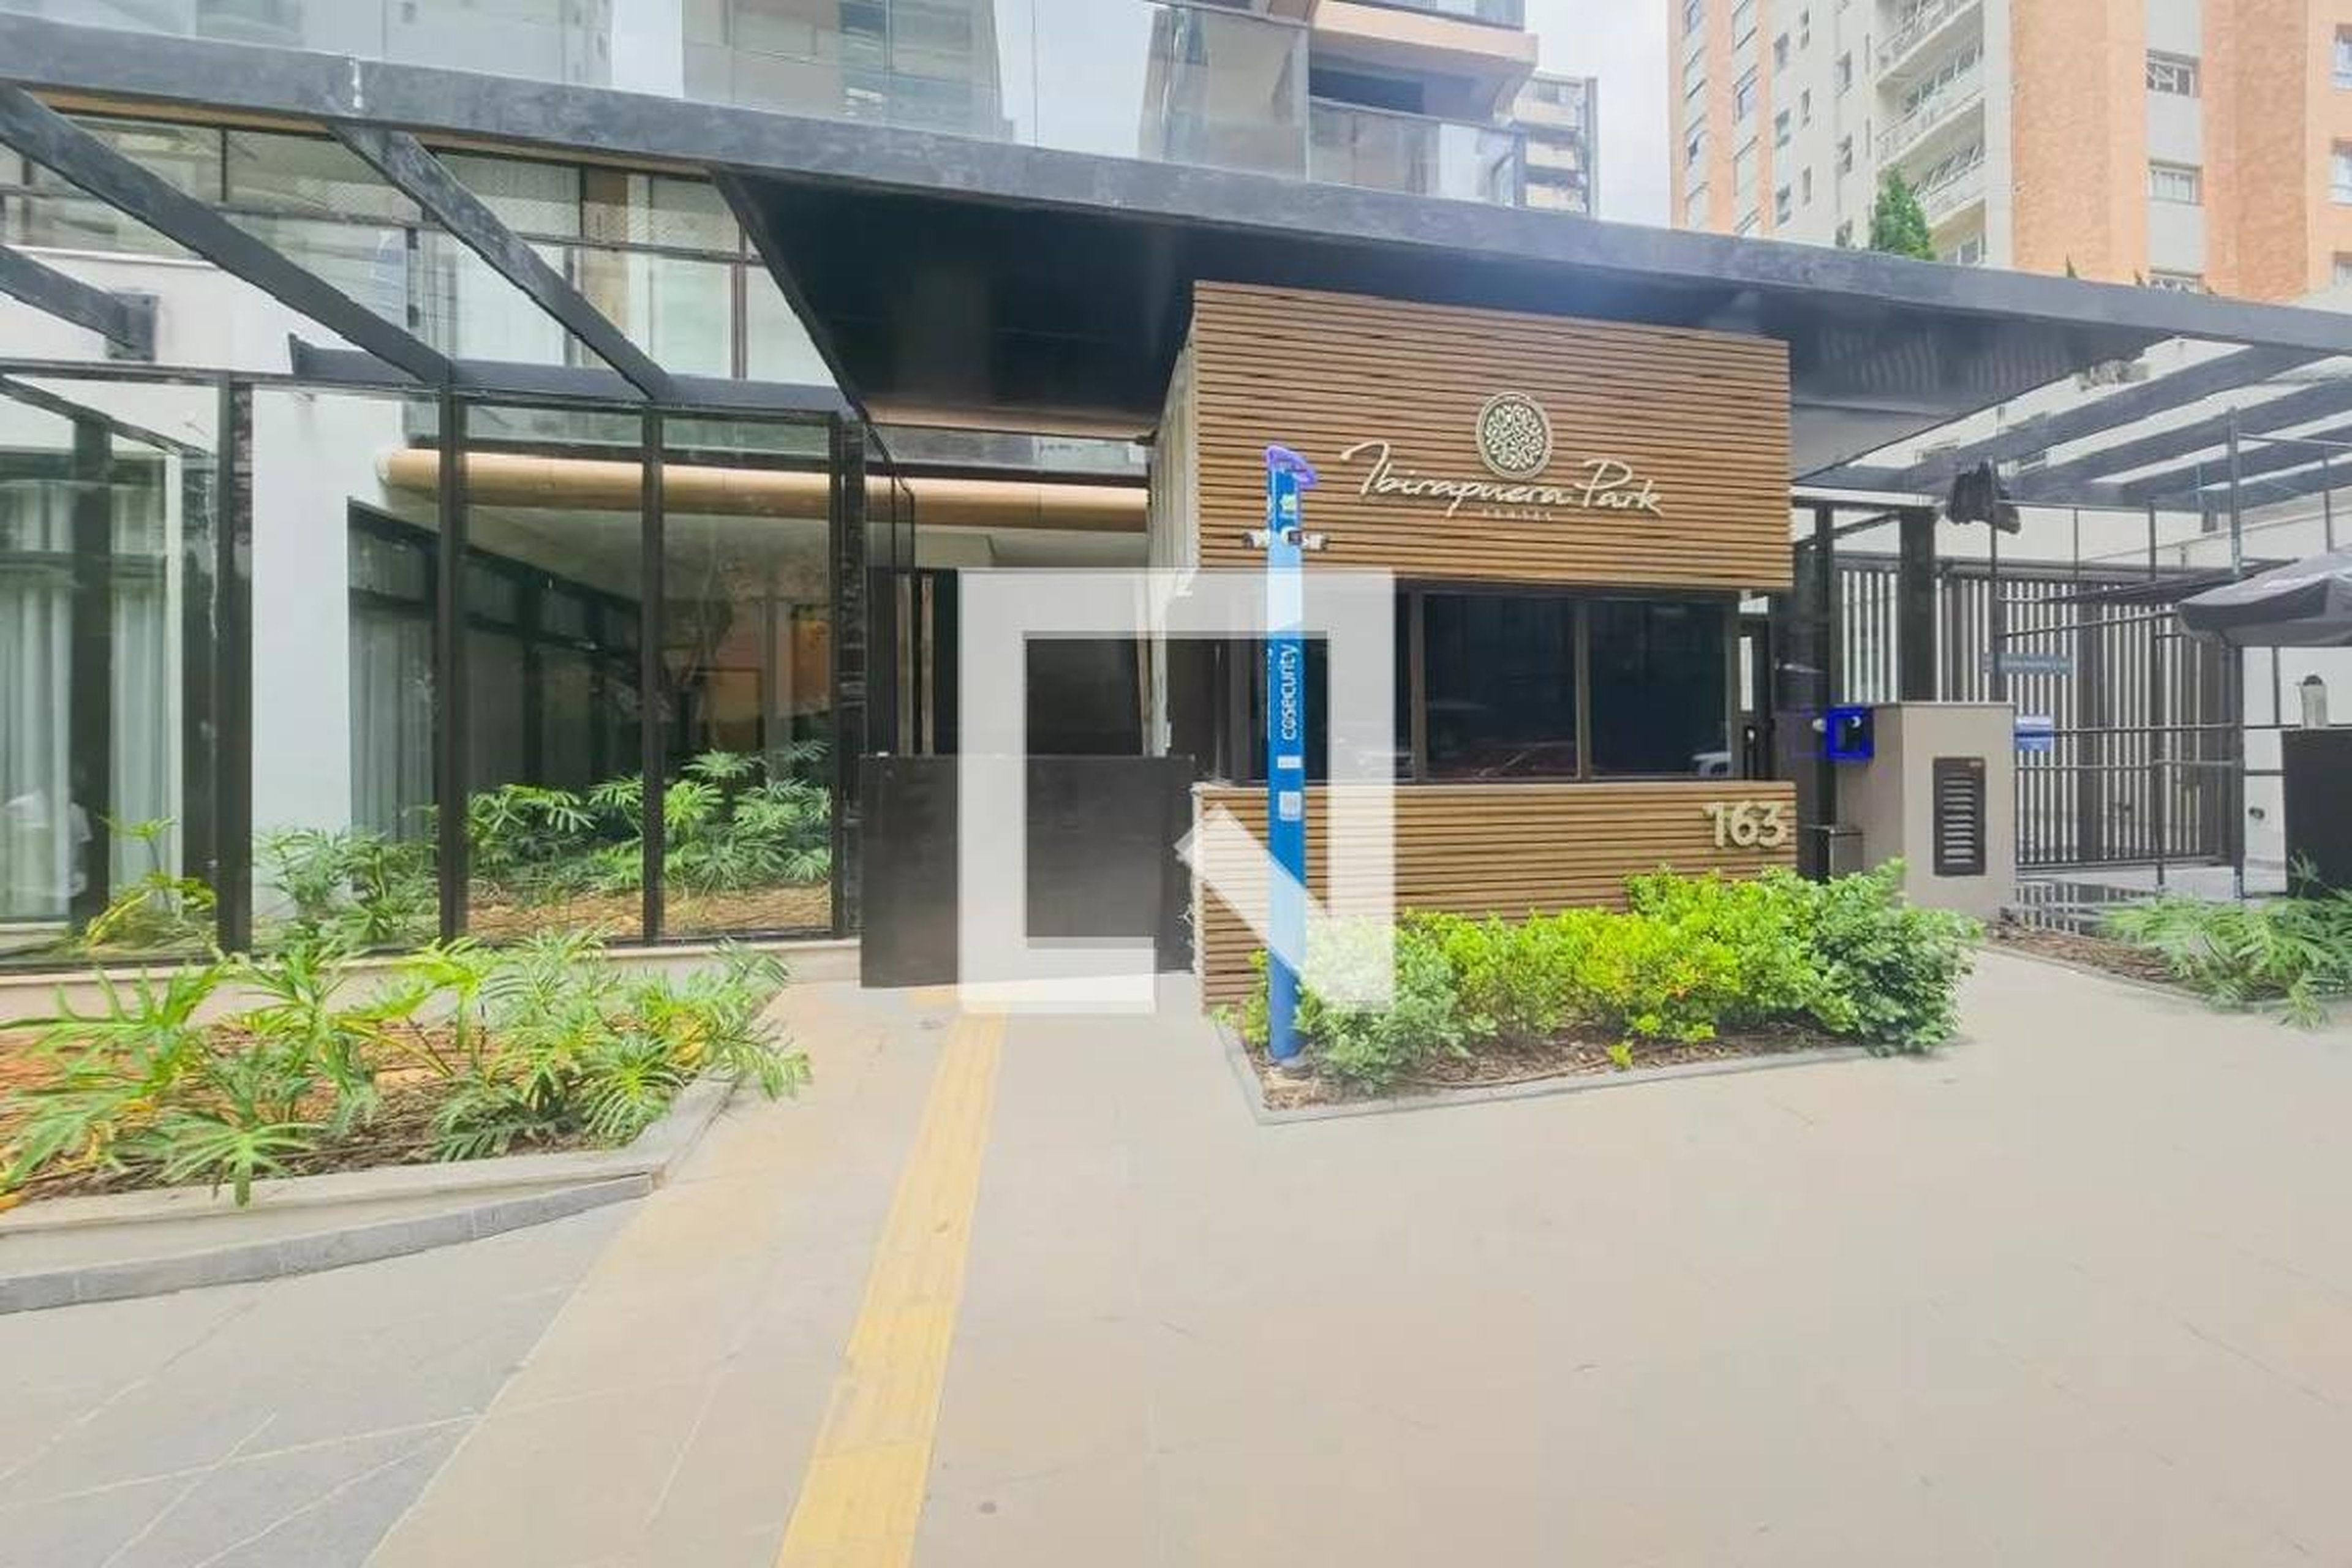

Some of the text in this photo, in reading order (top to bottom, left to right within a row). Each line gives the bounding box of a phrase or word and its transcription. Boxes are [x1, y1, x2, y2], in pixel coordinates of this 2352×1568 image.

[1340, 440, 1664, 518] Ibirapuera Park
[1702, 801, 1787, 848] 163
